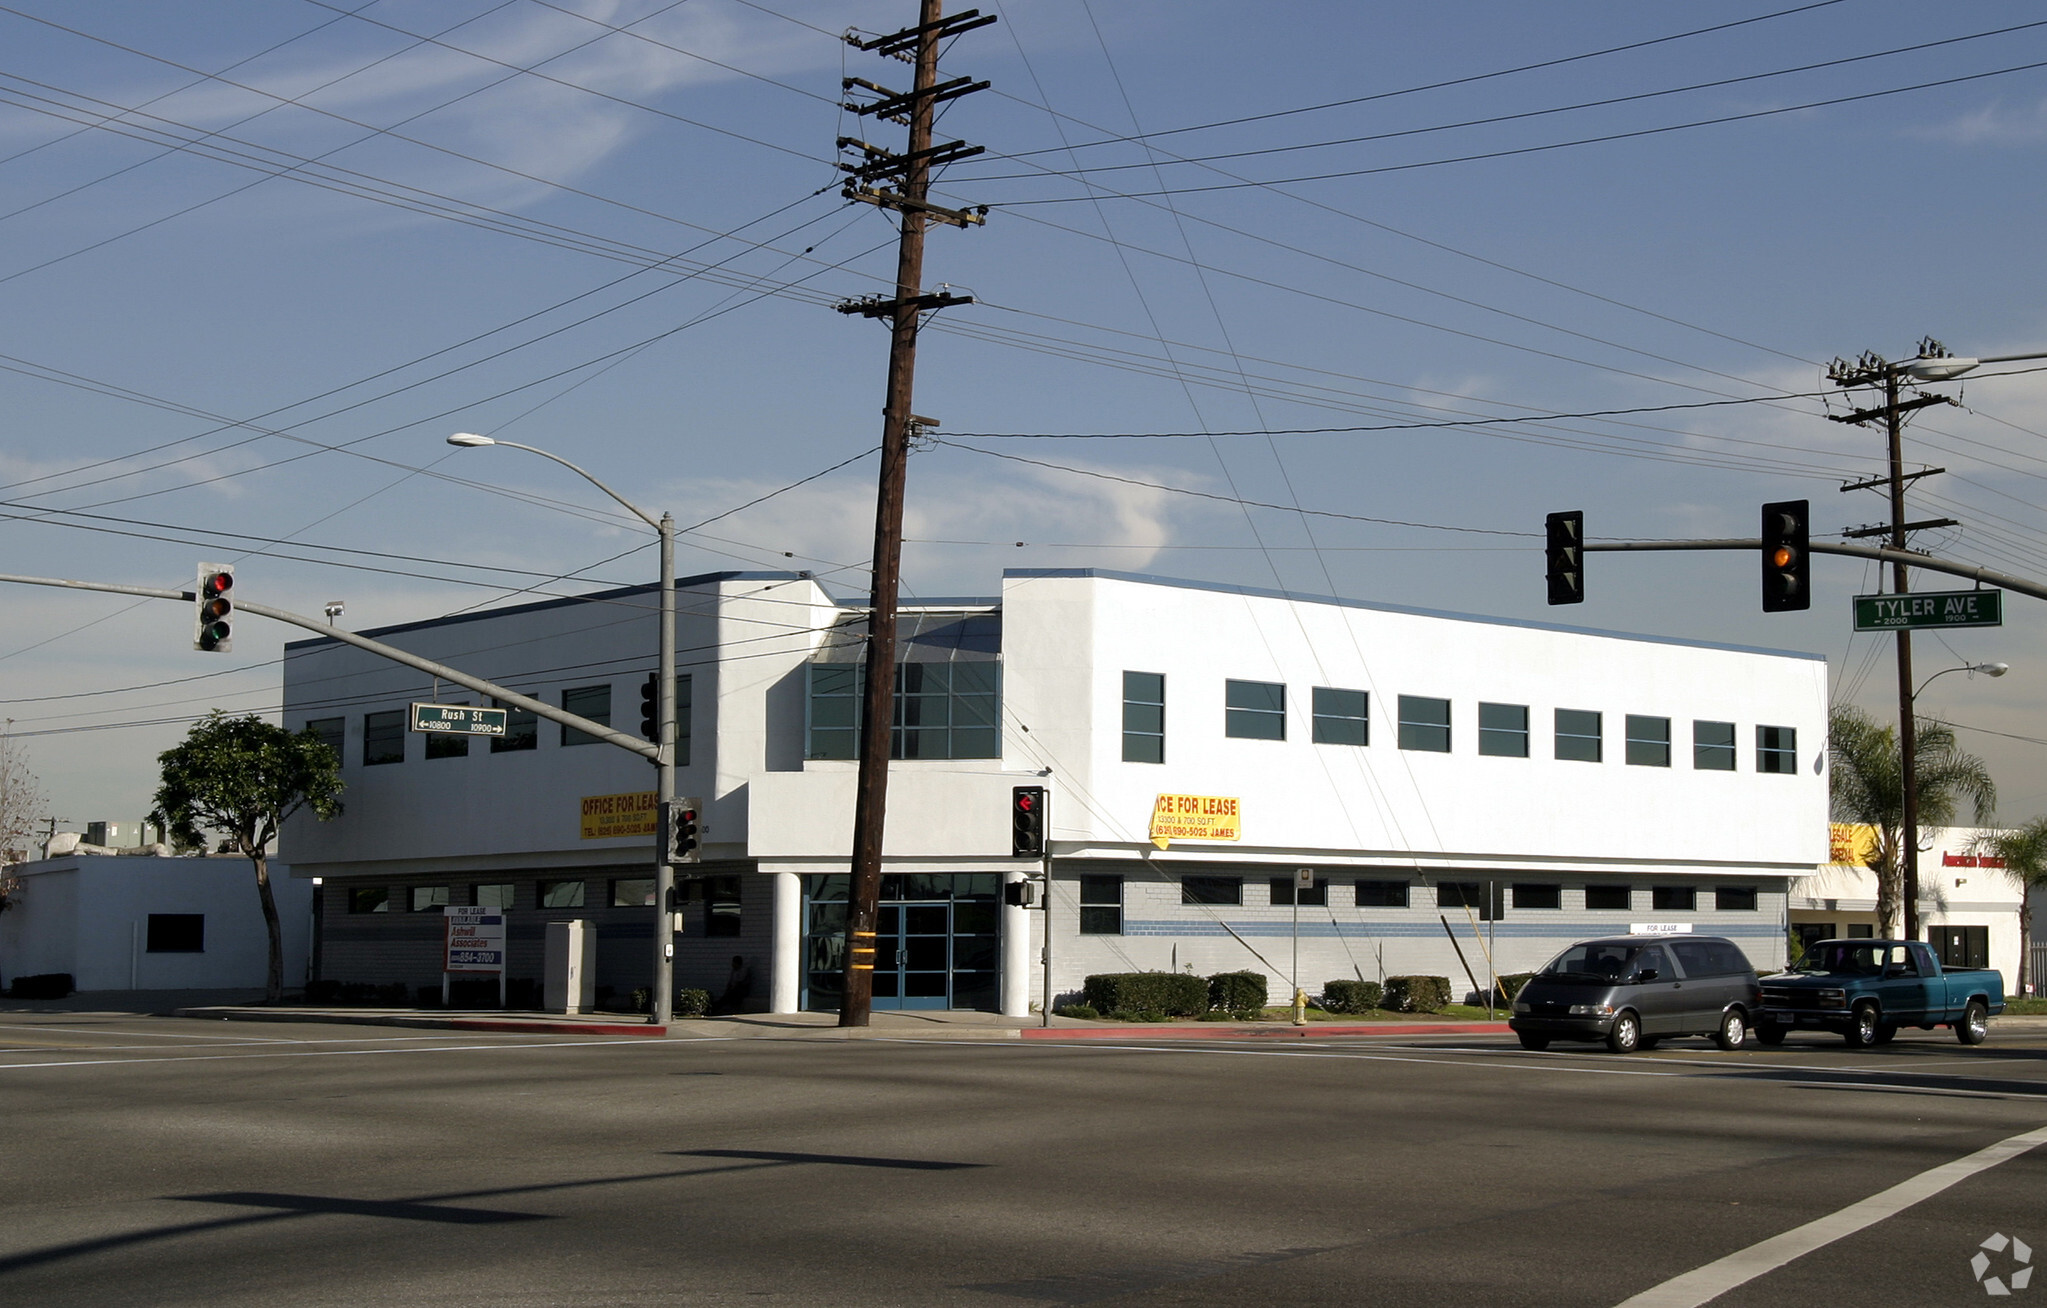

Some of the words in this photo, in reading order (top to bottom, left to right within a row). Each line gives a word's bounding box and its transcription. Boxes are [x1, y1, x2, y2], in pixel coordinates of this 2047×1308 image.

[1875, 598, 1935, 617] TYLER
[1944, 597, 1978, 614] AVE
[1884, 617, 1908, 625] 2000
[1945, 614, 1966, 622] 1900
[441, 709, 465, 721] Rush
[472, 711, 483, 722] St
[429, 720, 452, 730] 10800
[470, 723, 492, 733] 10900
[583, 797, 613, 816] OFFICE
[616, 795, 634, 813] FOR
[637, 793, 659, 811] LEAS
[1178, 797, 1199, 814] FOR
[1203, 798, 1236, 816] LEASE
[643, 822, 656, 833] JAM
[1211, 827, 1235, 838] JAMES
[1647, 924, 1658, 932] FOR
[1660, 924, 1678, 932] LEASE
[451, 938, 488, 948] Associates
